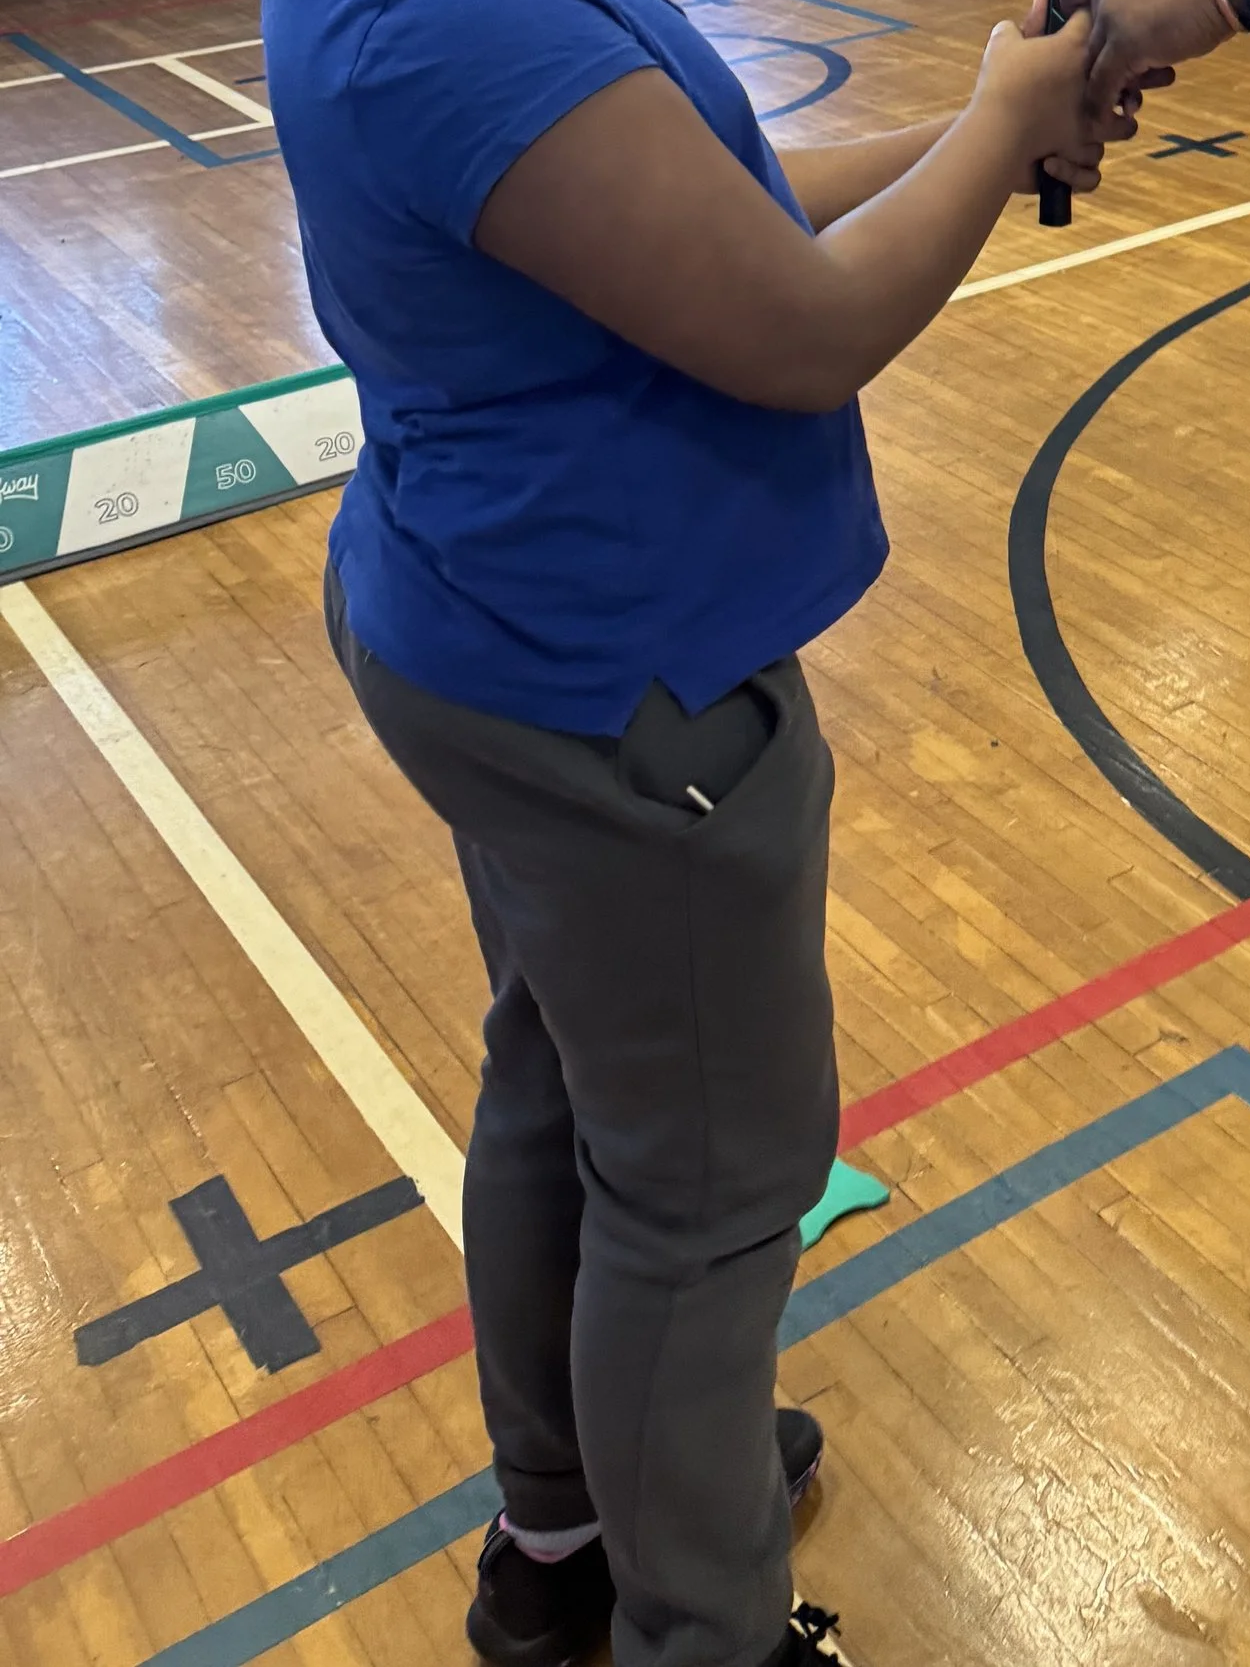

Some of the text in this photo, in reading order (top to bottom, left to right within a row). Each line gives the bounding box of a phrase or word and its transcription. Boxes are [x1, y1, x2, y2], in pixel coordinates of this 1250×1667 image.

[314, 431, 356, 462] 20
[215, 459, 257, 490] 50
[94, 491, 140, 525] 20
